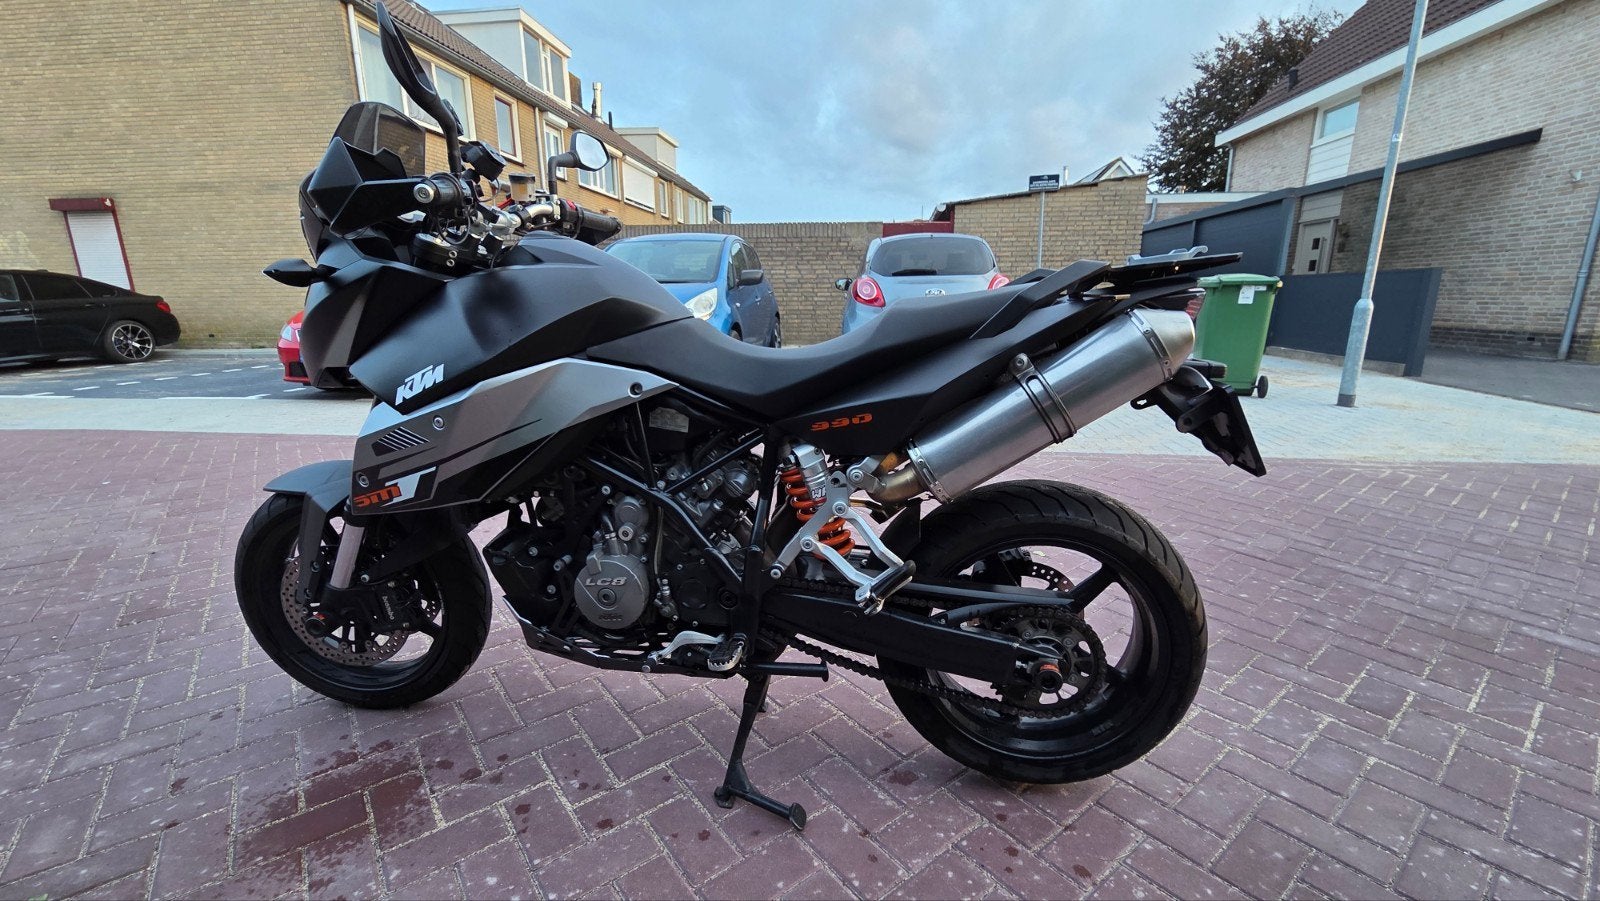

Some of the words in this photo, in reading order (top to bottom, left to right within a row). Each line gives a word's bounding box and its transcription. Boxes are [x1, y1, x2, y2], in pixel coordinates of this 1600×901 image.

[395, 363, 444, 406] KTM
[811, 413, 873, 431] 990
[585, 576, 627, 586] LC8
